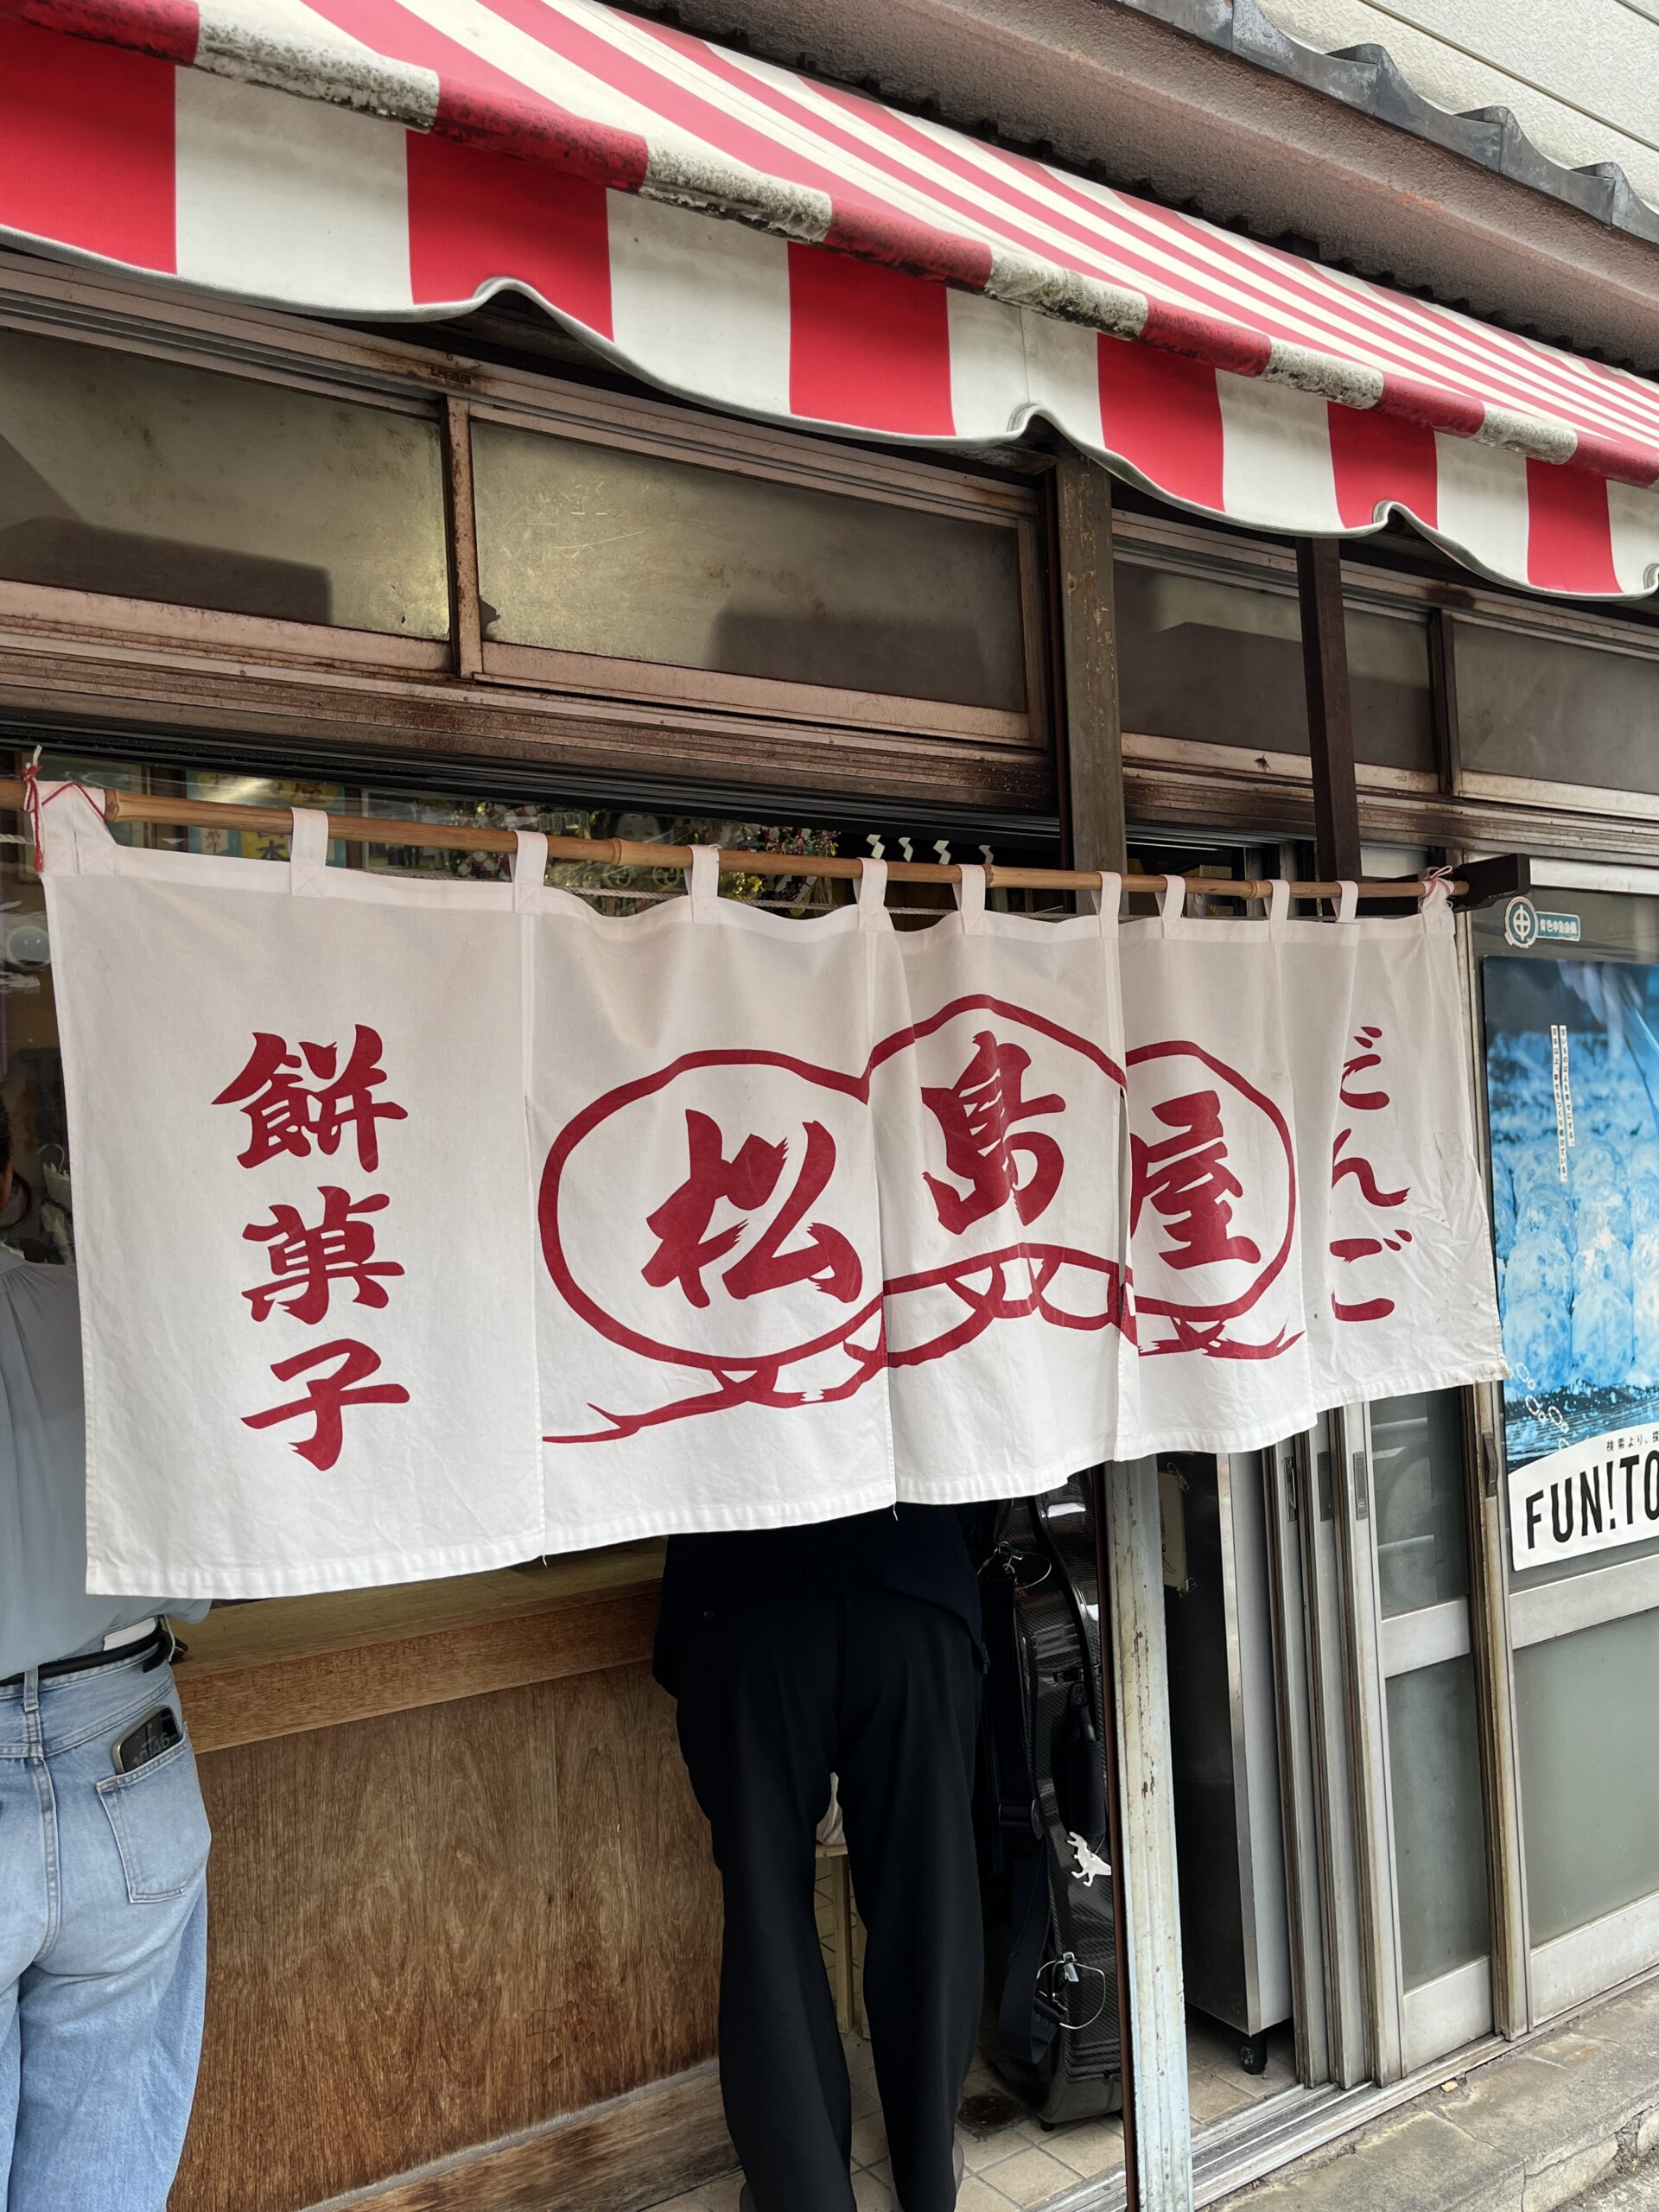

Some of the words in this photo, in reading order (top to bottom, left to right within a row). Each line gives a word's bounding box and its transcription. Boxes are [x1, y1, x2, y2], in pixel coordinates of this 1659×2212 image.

[211, 1024, 410, 1471] 餅菓子
[641, 1031, 1262, 1308] 松島屋
